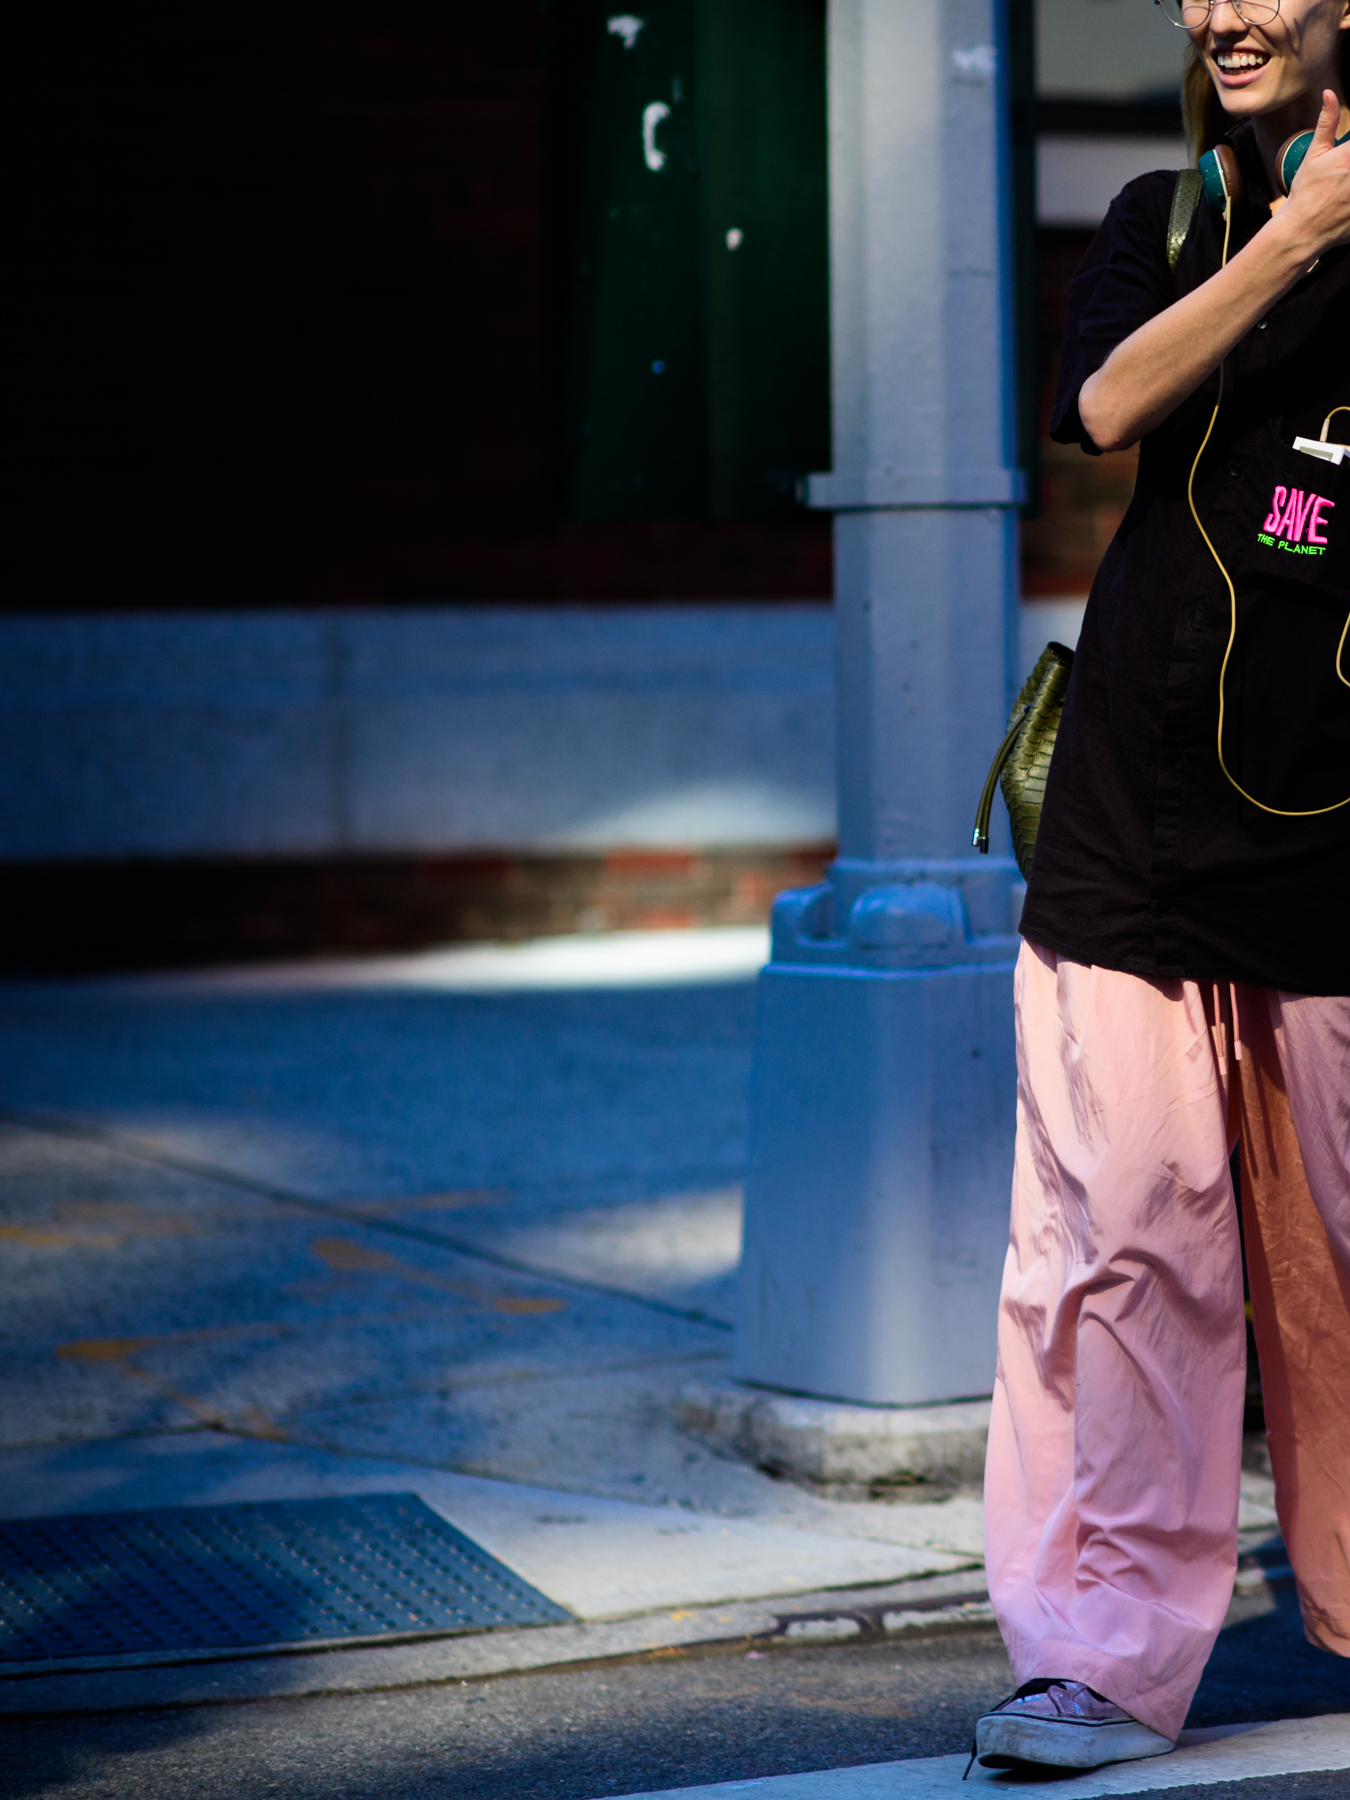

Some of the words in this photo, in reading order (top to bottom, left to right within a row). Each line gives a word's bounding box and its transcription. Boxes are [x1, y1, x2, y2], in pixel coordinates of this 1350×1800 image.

[1263, 485, 1335, 544] SAVE
[1257, 533, 1275, 546] THE
[1278, 541, 1326, 555] PLANET
